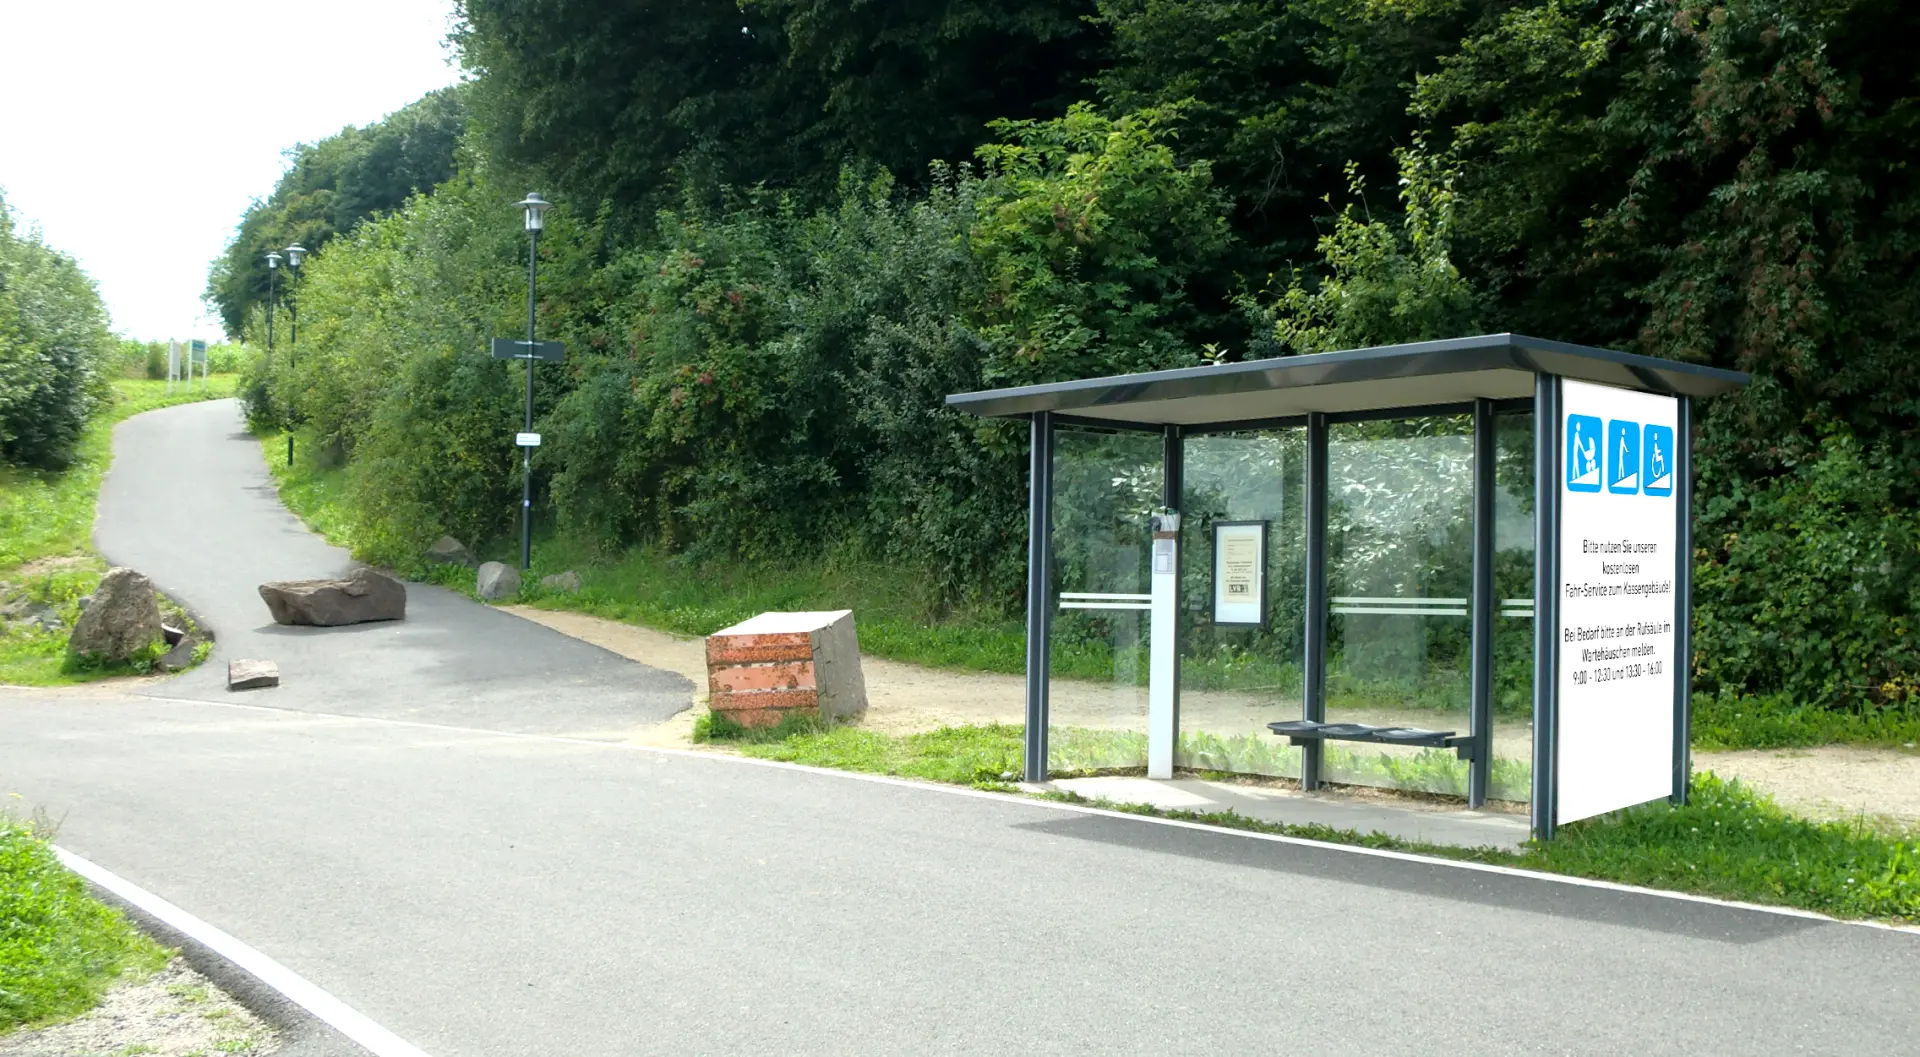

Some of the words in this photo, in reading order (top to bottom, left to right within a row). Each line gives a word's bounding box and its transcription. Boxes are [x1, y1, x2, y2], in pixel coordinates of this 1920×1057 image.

[1583, 540, 1598, 553] Bitte
[1600, 541, 1621, 553] nutzen
[1622, 540, 1632, 553] Sie
[1633, 541, 1657, 553] unseren
[1603, 562, 1639, 574] kostenlosen
[1566, 583, 1607, 598] Fahr-Service
[1609, 585, 1622, 595] zum
[1624, 580, 1671, 597] Kassengebäude!
[1565, 628, 1575, 642] Bei
[1578, 626, 1600, 641] Bedarf
[1601, 625, 1614, 639] bitte
[1616, 627, 1624, 637] an
[1625, 624, 1635, 636] der
[1637, 622, 1662, 635] Rufsäule
[1664, 621, 1670, 633] im
[1582, 646, 1630, 662] Wartehäuschen
[1632, 643, 1655, 656] melden.
[1573, 671, 1587, 685] 9:00
[1594, 668, 1610, 682] 12:30
[1612, 670, 1624, 680] und
[1625, 664, 1641, 678] 13:30
[1647, 661, 1662, 675] 16:00
